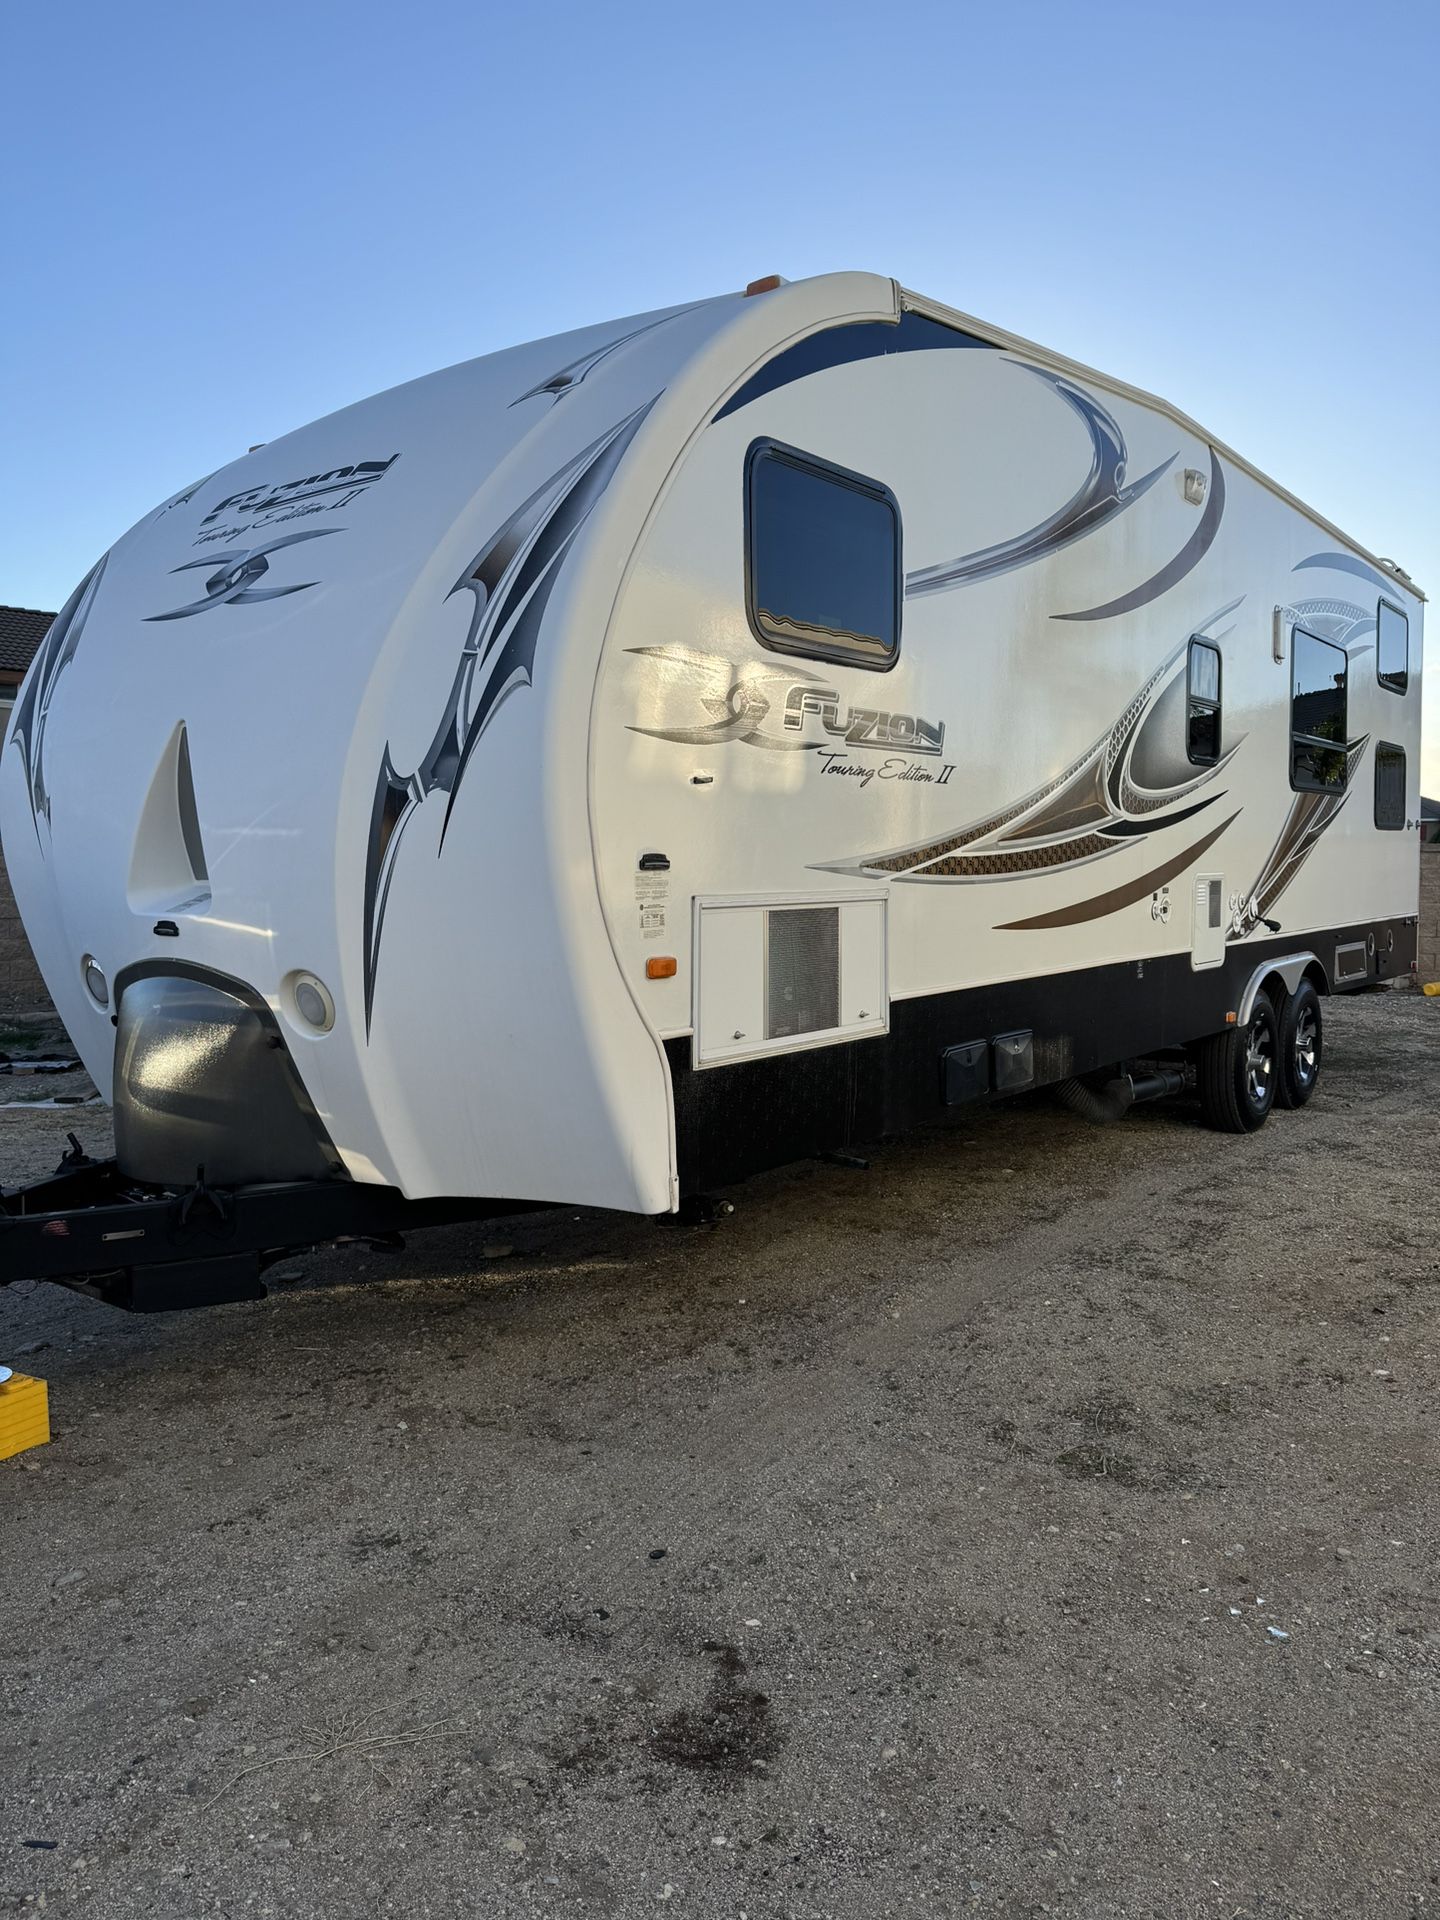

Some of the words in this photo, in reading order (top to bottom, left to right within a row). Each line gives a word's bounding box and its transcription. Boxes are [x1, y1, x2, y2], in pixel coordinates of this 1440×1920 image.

[192, 524, 251, 546] Touring
[252, 503, 327, 528] Edition
[326, 487, 371, 511] II
[784, 684, 946, 756] FUZION
[817, 750, 875, 788] Touring
[877, 758, 934, 784] Edition
[934, 764, 957, 784] II
